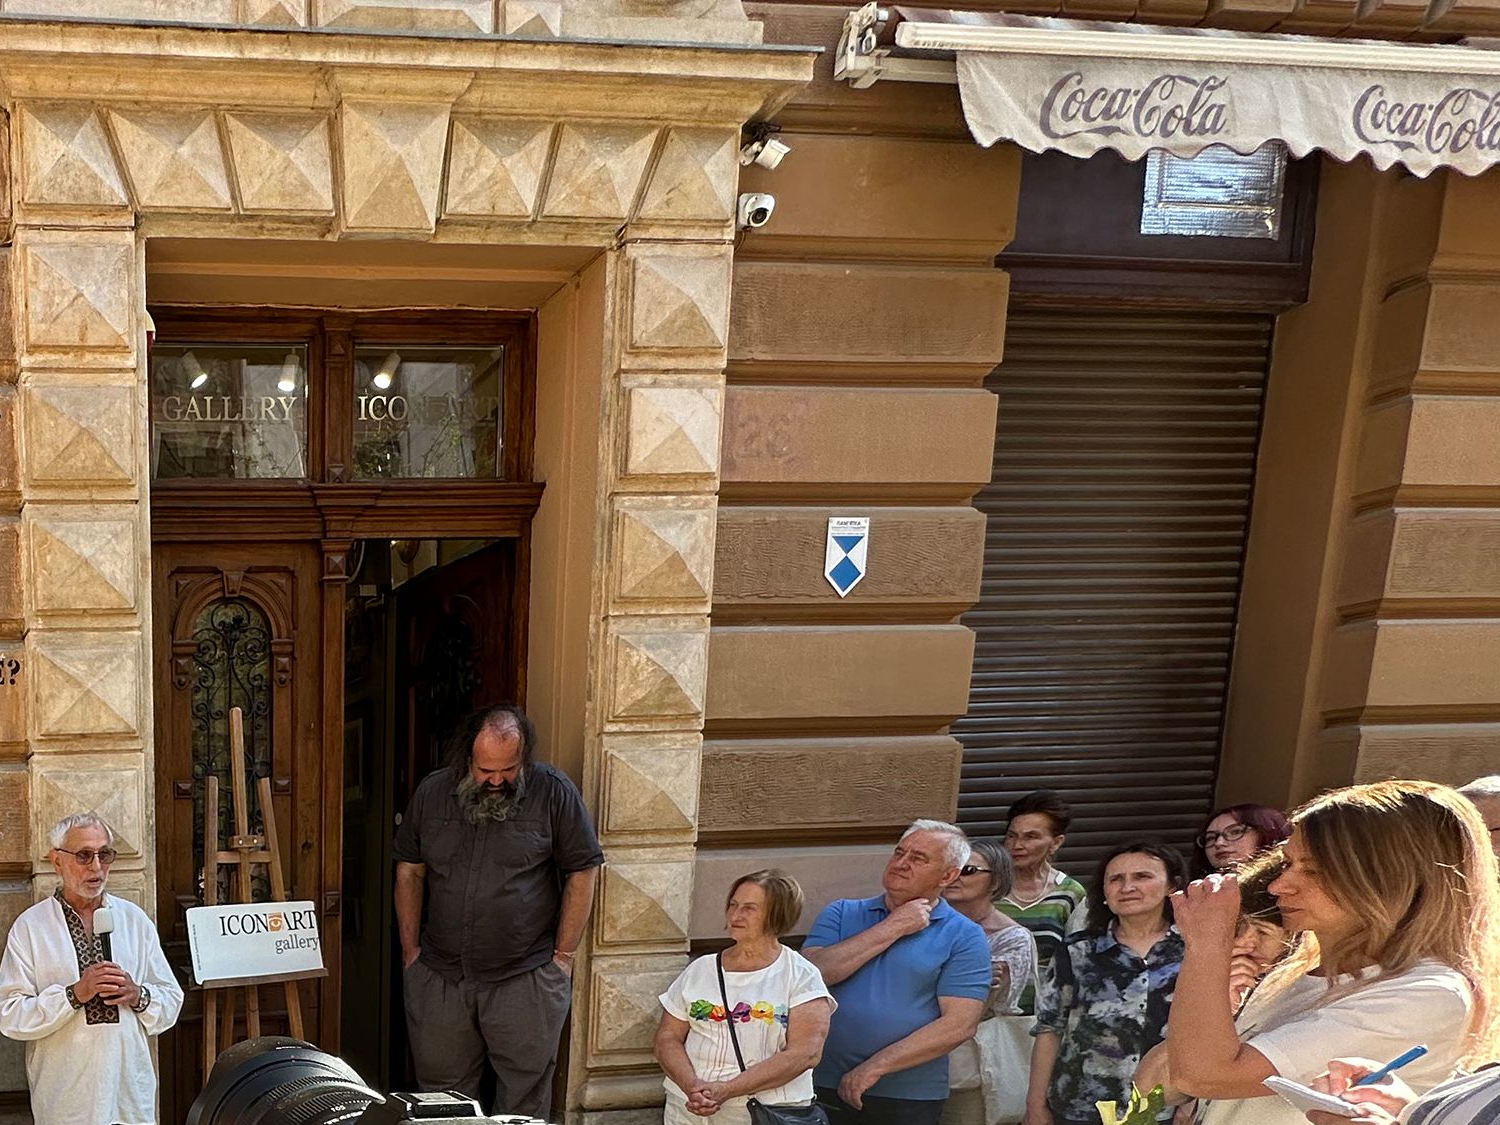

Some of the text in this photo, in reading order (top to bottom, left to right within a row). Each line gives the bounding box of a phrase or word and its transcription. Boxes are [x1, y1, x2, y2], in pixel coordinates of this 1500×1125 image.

[1039, 72, 1229, 139] Coca-Cola
[162, 395, 297, 422] GALLERY
[219, 909, 317, 937] ICON ART
[275, 933, 320, 955] gallery
